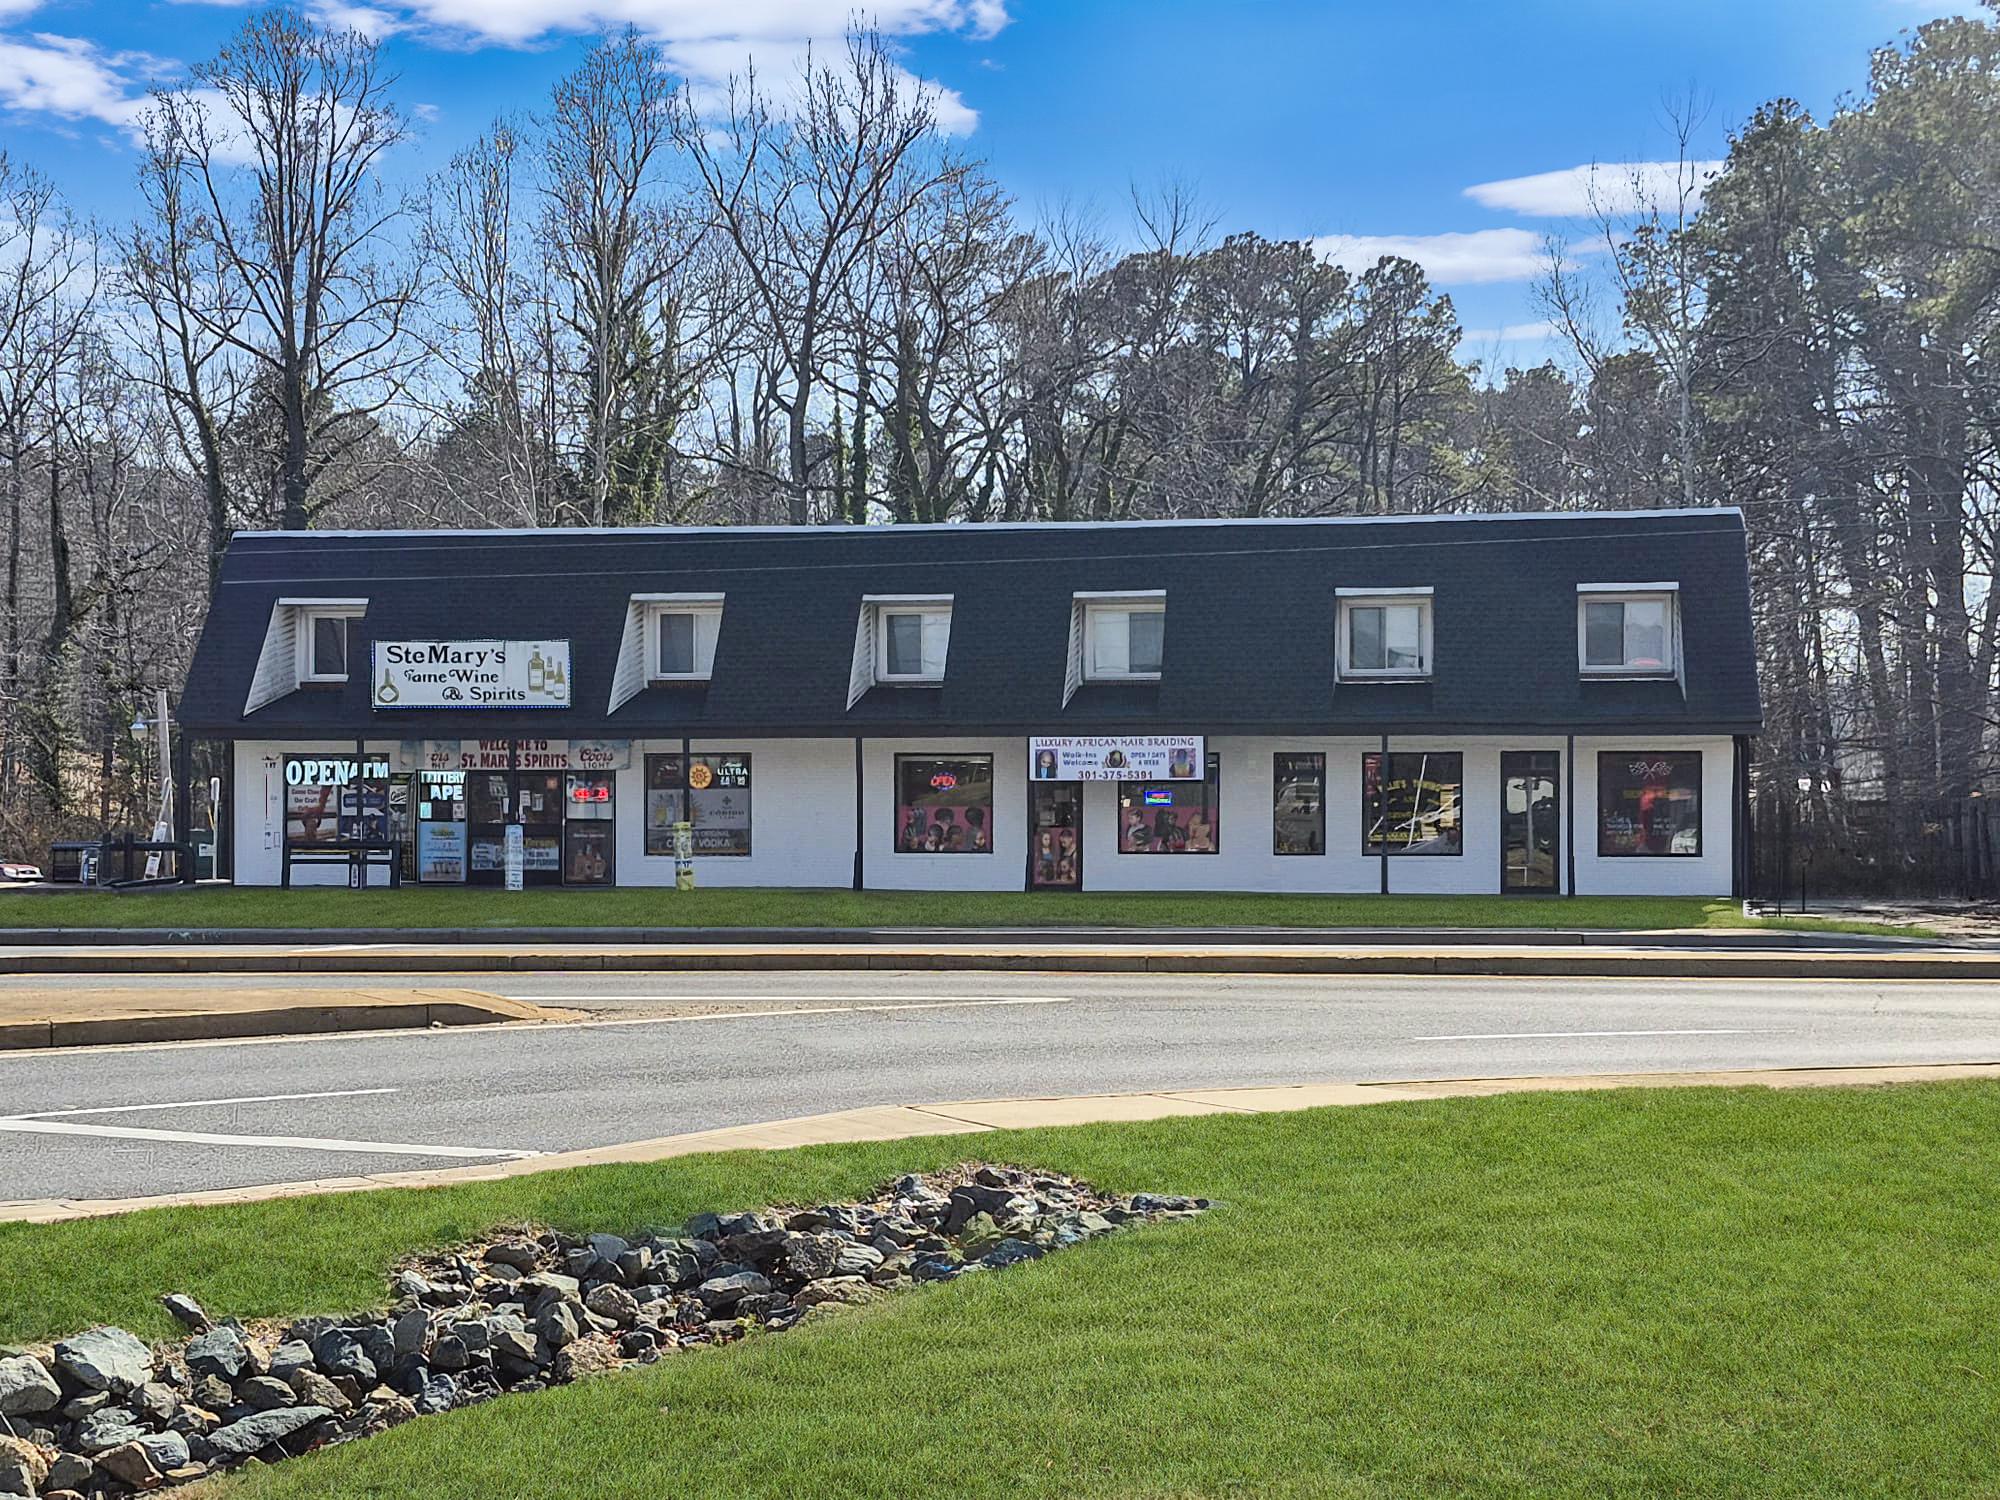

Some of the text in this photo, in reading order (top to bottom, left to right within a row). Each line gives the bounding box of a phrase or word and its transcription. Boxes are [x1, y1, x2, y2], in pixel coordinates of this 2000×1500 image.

[449, 668, 499, 683] Wine
[470, 686, 526, 703] Spirits
[480, 739, 548, 751] WELCME TO
[1035, 737, 1194, 747] LUXURY AFRICAN HAIR BRAIDING
[480, 752, 522, 769] MARYS
[524, 752, 567, 769] SPIRITS
[580, 748, 614, 762] Coors
[286, 760, 350, 785] OPEN
[717, 767, 749, 776] ULTRA
[1078, 770, 1153, 780] 301-375-5391
